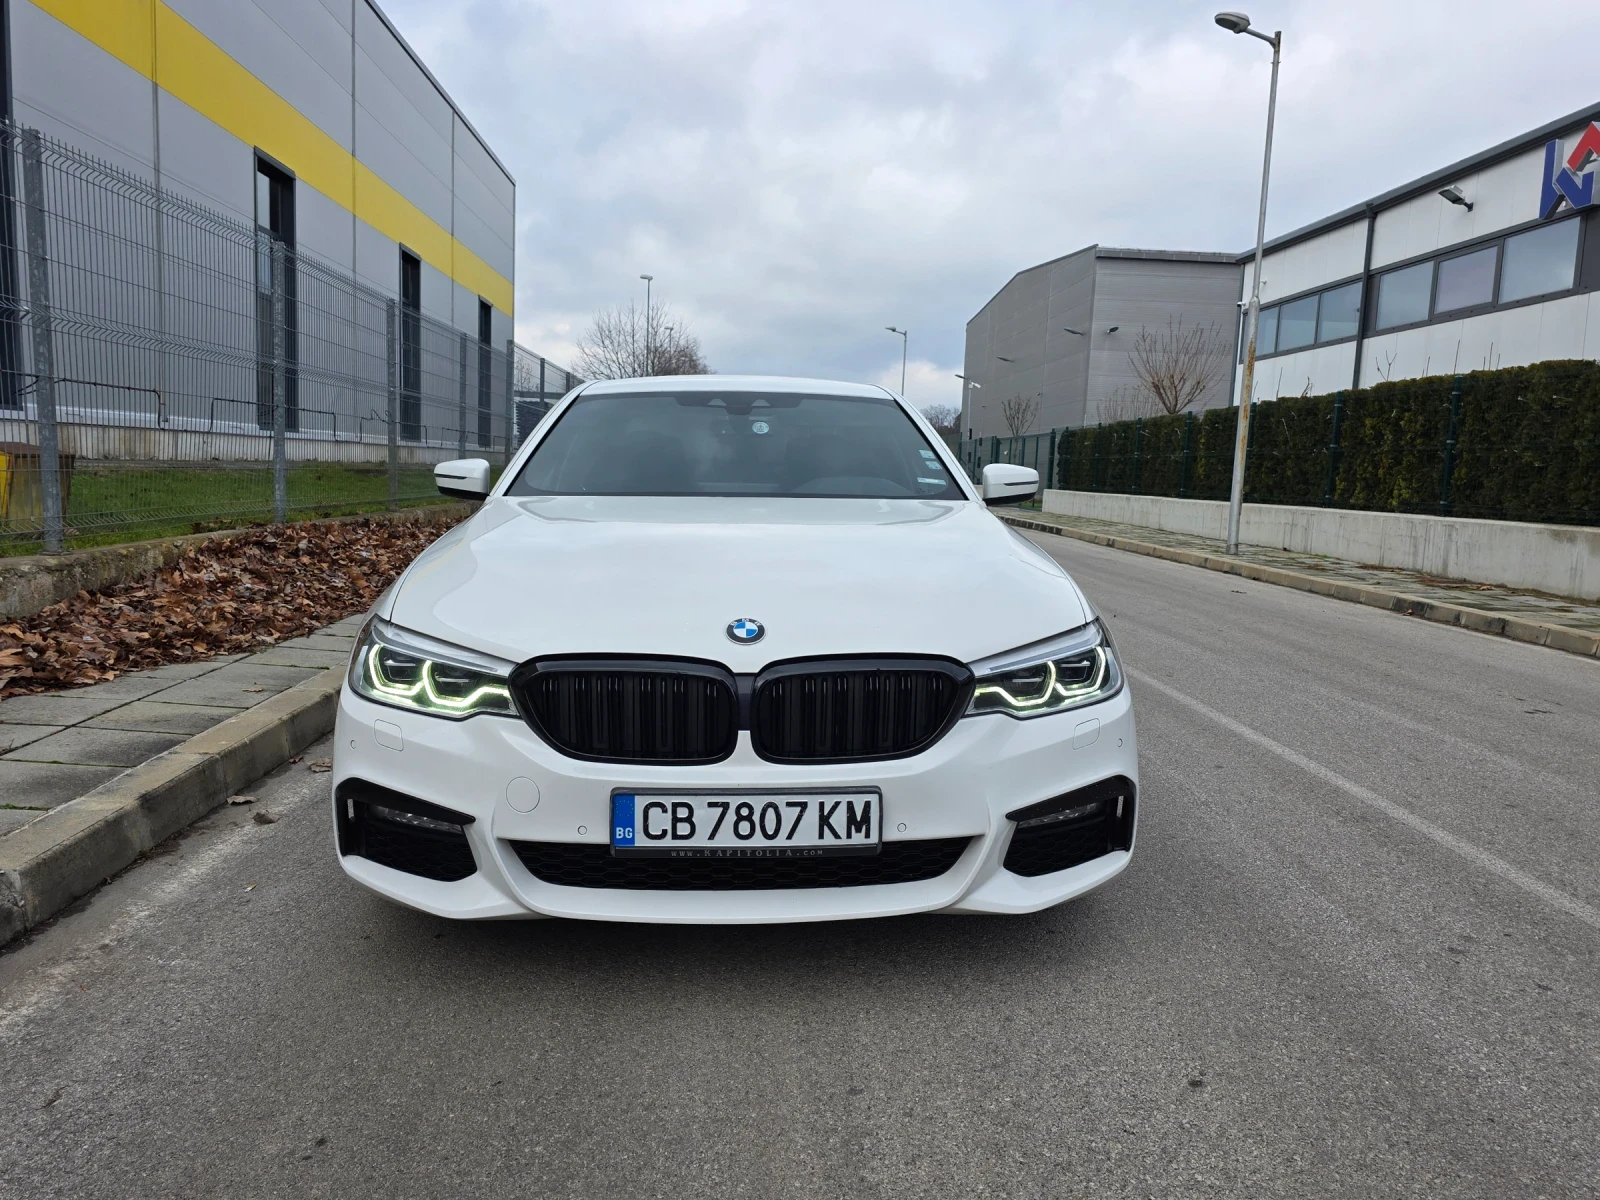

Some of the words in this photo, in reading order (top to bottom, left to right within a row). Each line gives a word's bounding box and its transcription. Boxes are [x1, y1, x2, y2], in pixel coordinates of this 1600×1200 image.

[616, 827, 633, 839] BG
[642, 801, 696, 841] CB
[706, 801, 809, 841] 7807
[817, 800, 872, 841] KM
